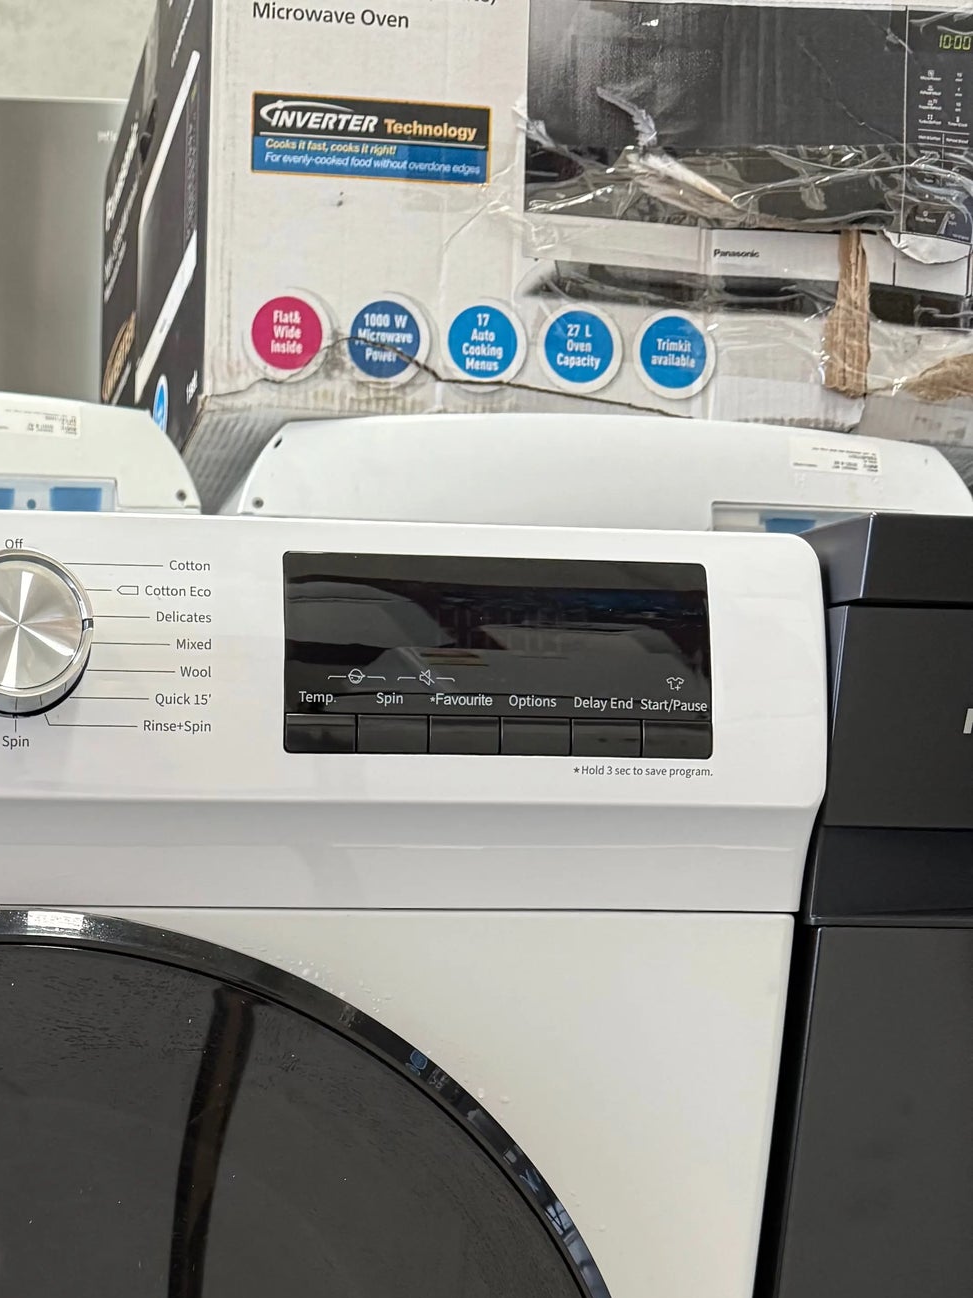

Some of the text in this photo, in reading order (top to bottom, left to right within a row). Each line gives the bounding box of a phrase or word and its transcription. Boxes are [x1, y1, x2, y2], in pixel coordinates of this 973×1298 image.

[252, 2, 409, 28] Microwave Oven
[939, 34, 971, 50] 10:00
[384, 118, 477, 141] Technology
[265, 138, 396, 156] Cooks it fast, cooks it right!
[265, 152, 481, 175] For evenly-cooked food without overdone edges
[713, 248, 760, 258] Panasonic
[364, 314, 408, 328] 1000 W
[476, 314, 489, 326] 17
[273, 326, 302, 339] Wide
[357, 329, 412, 343] Microwave
[471, 330, 495, 342] Auto
[567, 325, 592, 337] 27 L
[462, 343, 502, 358] Cooking
[566, 341, 592, 353] Oven
[656, 339, 692, 352] Trimkit
[465, 358, 499, 371] Menus
[556, 353, 601, 370] Capacity
[651, 354, 695, 368] available
[4, 538, 24, 549] Off
[169, 560, 211, 571] Cotton
[145, 585, 212, 598] Cotton Eco
[156, 611, 212, 623] Delicates
[176, 638, 212, 650] Mixed
[180, 666, 212, 678] Wool
[155, 693, 191, 707] Quick
[298, 690, 337, 706] Temp.
[376, 693, 404, 707] Spin
[508, 695, 557, 710] Options
[573, 696, 633, 711] Delay End
[640, 698, 708, 712] Start/Pause
[143, 720, 212, 735] Rinse+Spin
[2, 736, 30, 749] Spin
[607, 766, 613, 775] 3
[615, 767, 630, 775] sec
[633, 767, 643, 776] to
[645, 768, 667, 776] save
[669, 768, 714, 778] program.
